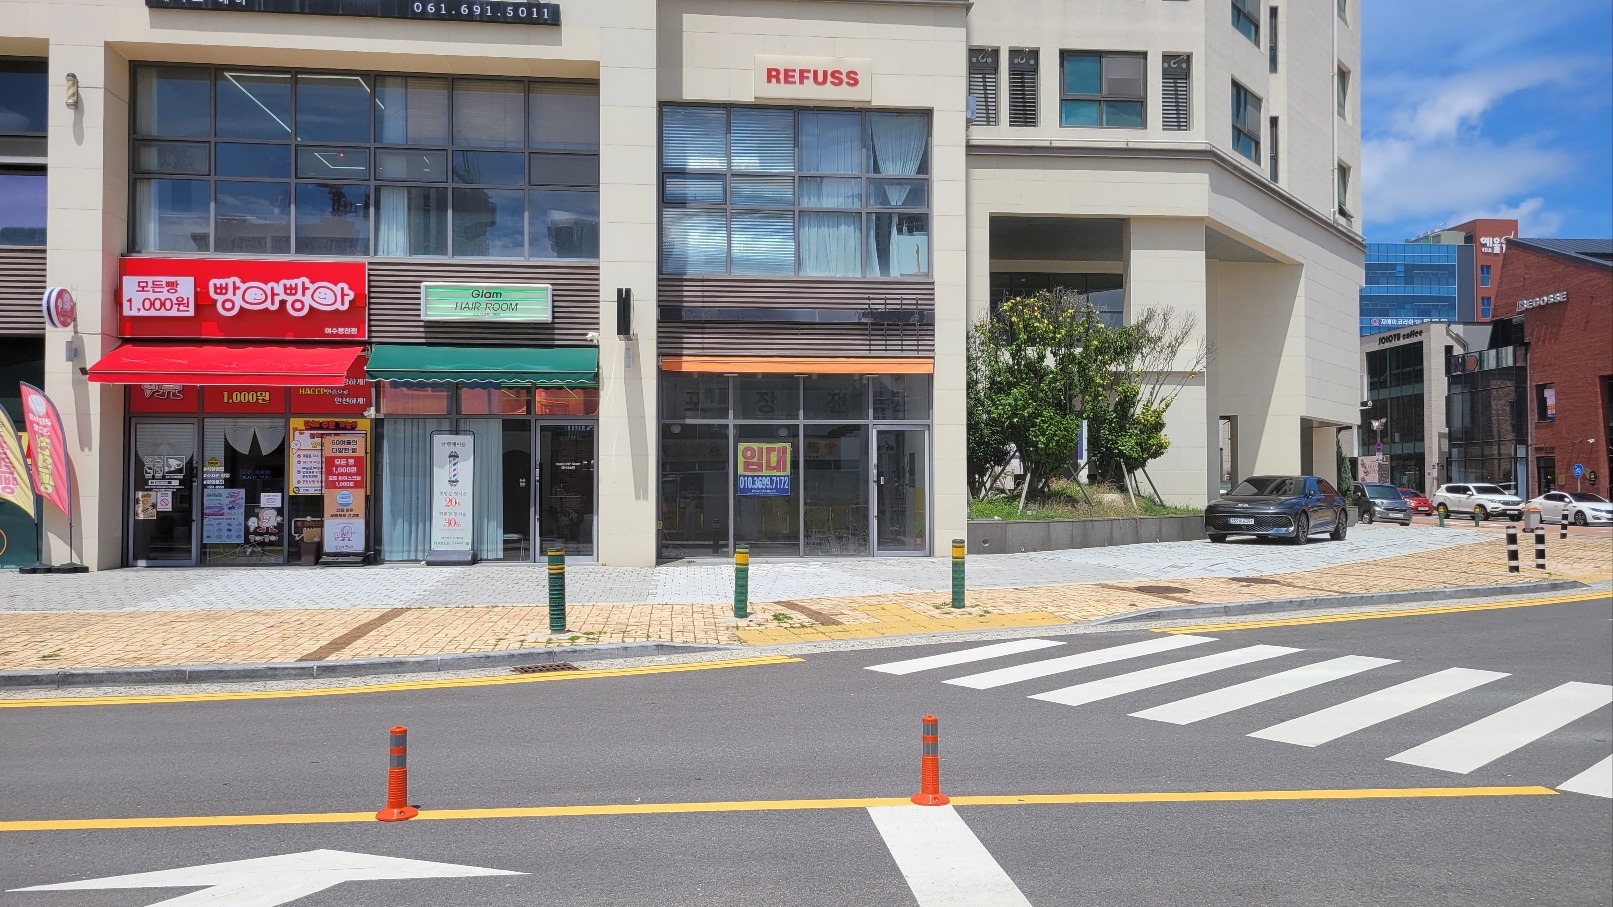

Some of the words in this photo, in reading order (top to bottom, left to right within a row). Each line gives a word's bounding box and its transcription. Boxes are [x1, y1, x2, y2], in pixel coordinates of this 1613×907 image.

[413, 2, 549, 19] 061.691.5011
[765, 67, 860, 88] REFUSS
[135, 279, 180, 294] 모든빵
[471, 289, 502, 299] Glam
[210, 278, 353, 315] 빵아빵아
[126, 296, 191, 314] 1,000원
[484, 302, 519, 312] ROOM
[1402, 329, 1423, 341] coffee
[222, 391, 270, 404] 1,000원
[741, 445, 788, 473] 임대
[739, 476, 789, 489] 010.3699.7172
